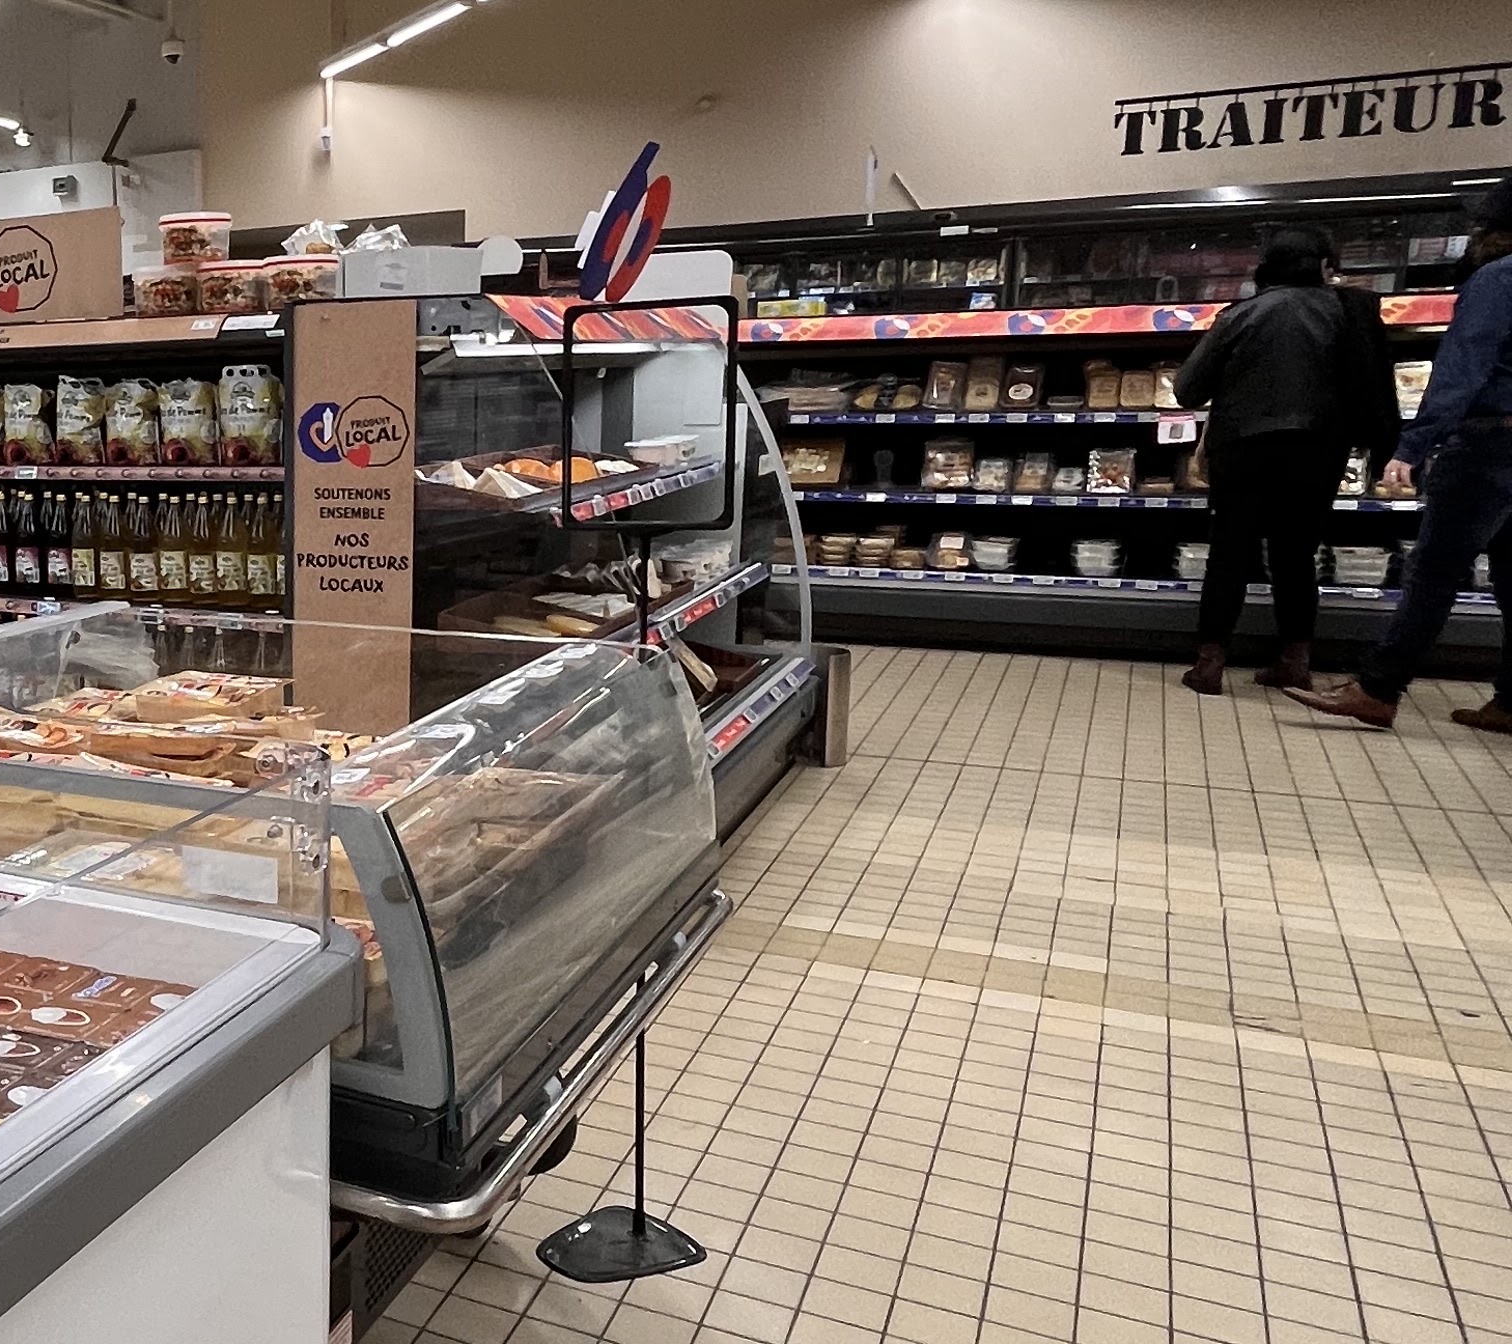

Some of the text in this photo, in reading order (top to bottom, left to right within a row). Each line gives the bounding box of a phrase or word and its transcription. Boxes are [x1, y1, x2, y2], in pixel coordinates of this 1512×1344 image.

[1114, 79, 1507, 156] TRAITEUR
[350, 416, 391, 430] PRODUIT
[345, 424, 402, 448] LOCAL
[314, 487, 391, 501] SOUTENONS
[319, 506, 385, 520] ENSEMBLE
[334, 532, 369, 548] NOS
[297, 552, 409, 571] PRODUCTEURS
[319, 575, 384, 593] LOCAUX
